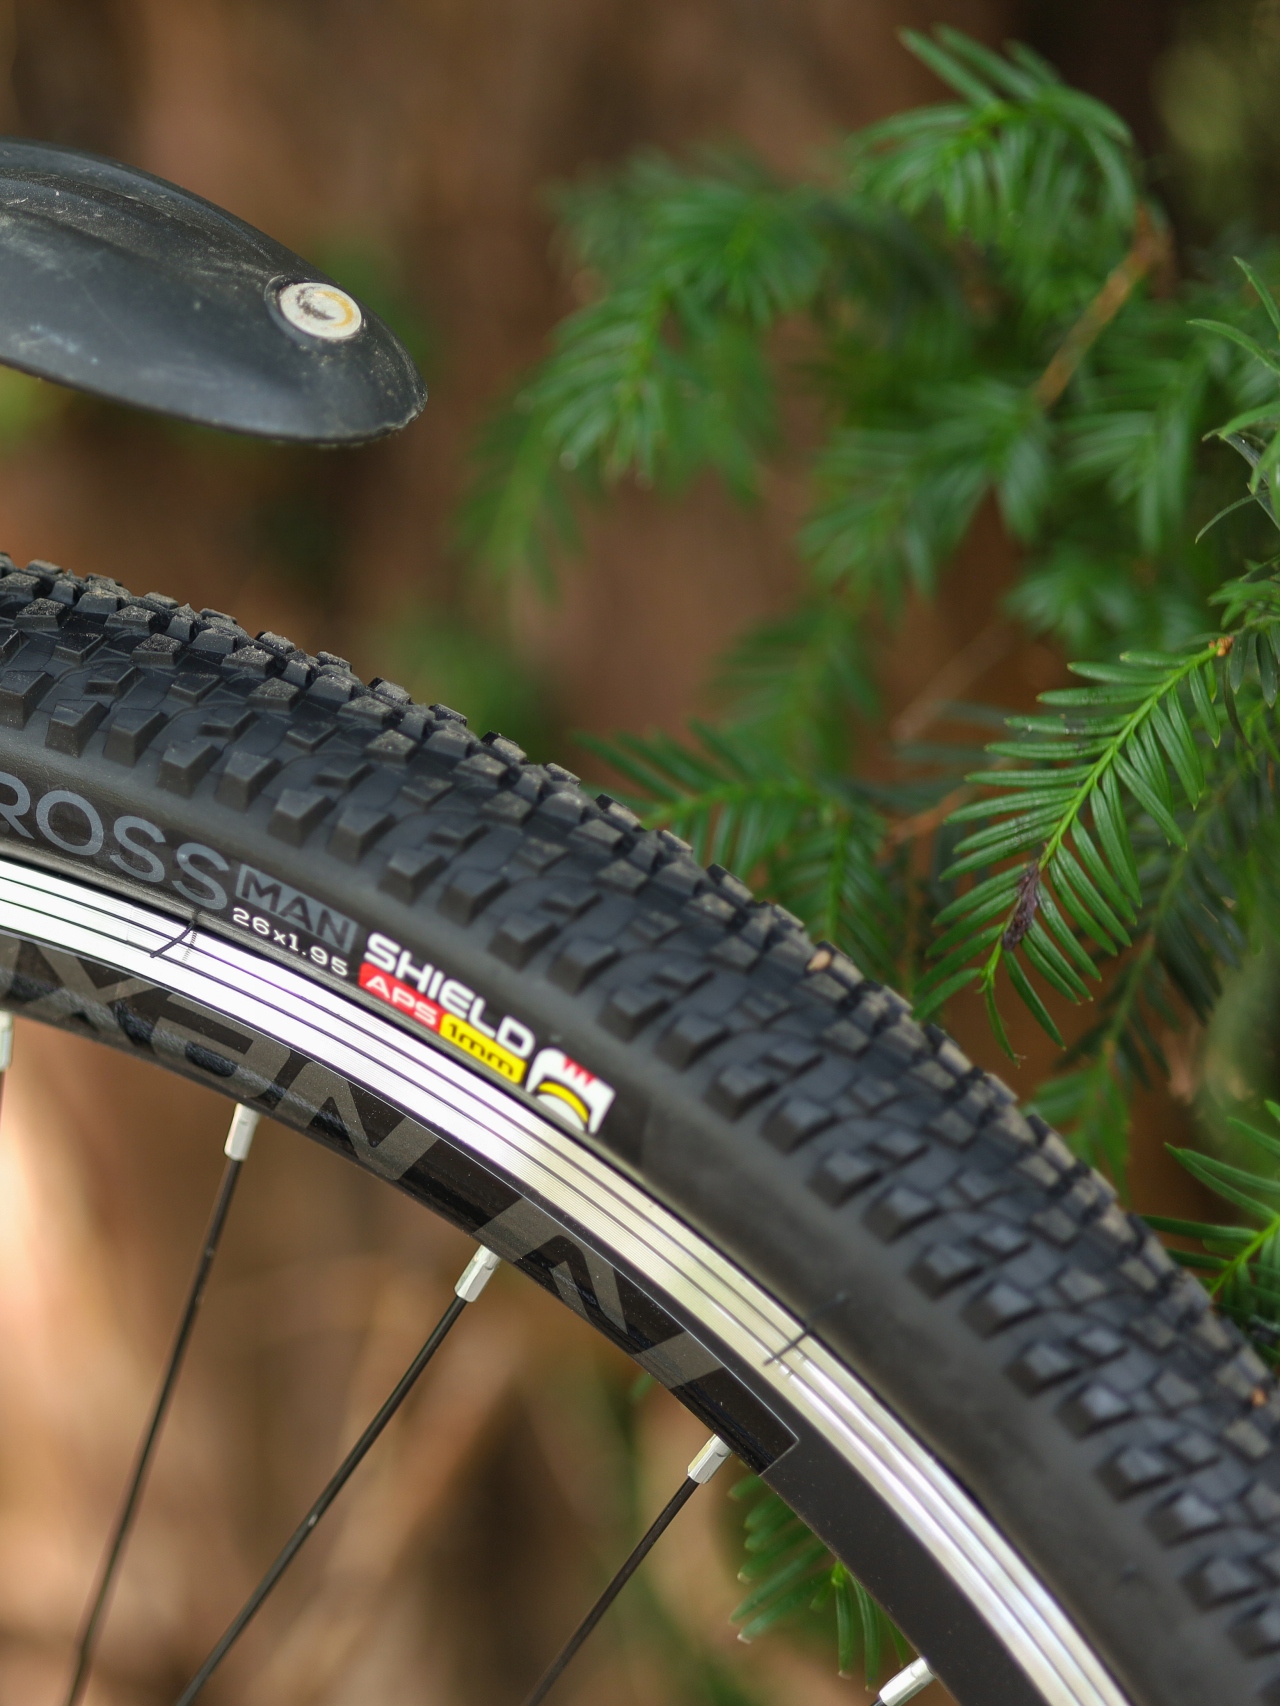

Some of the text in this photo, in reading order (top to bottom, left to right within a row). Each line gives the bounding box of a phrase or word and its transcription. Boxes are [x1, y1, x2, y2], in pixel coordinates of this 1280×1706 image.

[232, 906, 349, 977] 26x1.95
[363, 931, 536, 1058] SHIELD
[365, 974, 515, 1078] APS 1mm
